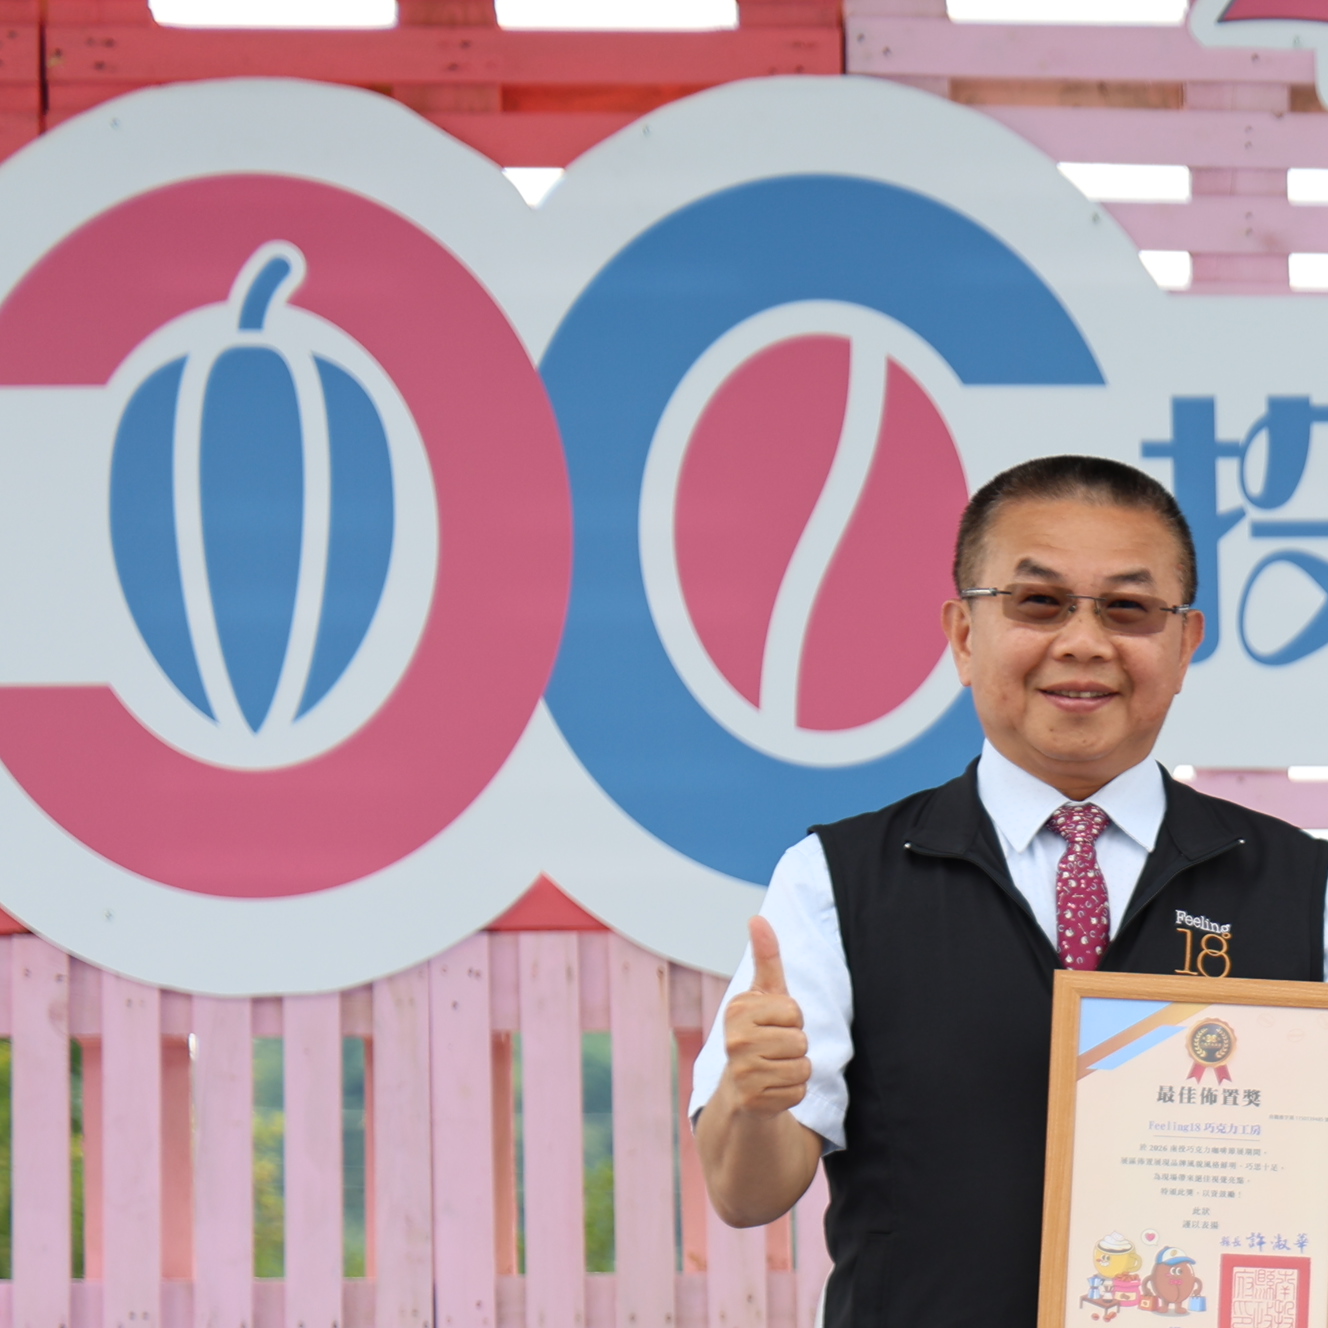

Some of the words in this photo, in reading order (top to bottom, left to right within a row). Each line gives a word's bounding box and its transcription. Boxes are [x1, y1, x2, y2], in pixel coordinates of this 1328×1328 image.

[1175, 909, 1233, 940] Feeling
[1174, 927, 1232, 977] 18
[1156, 1085, 1261, 1108] 最佳佈置獎
